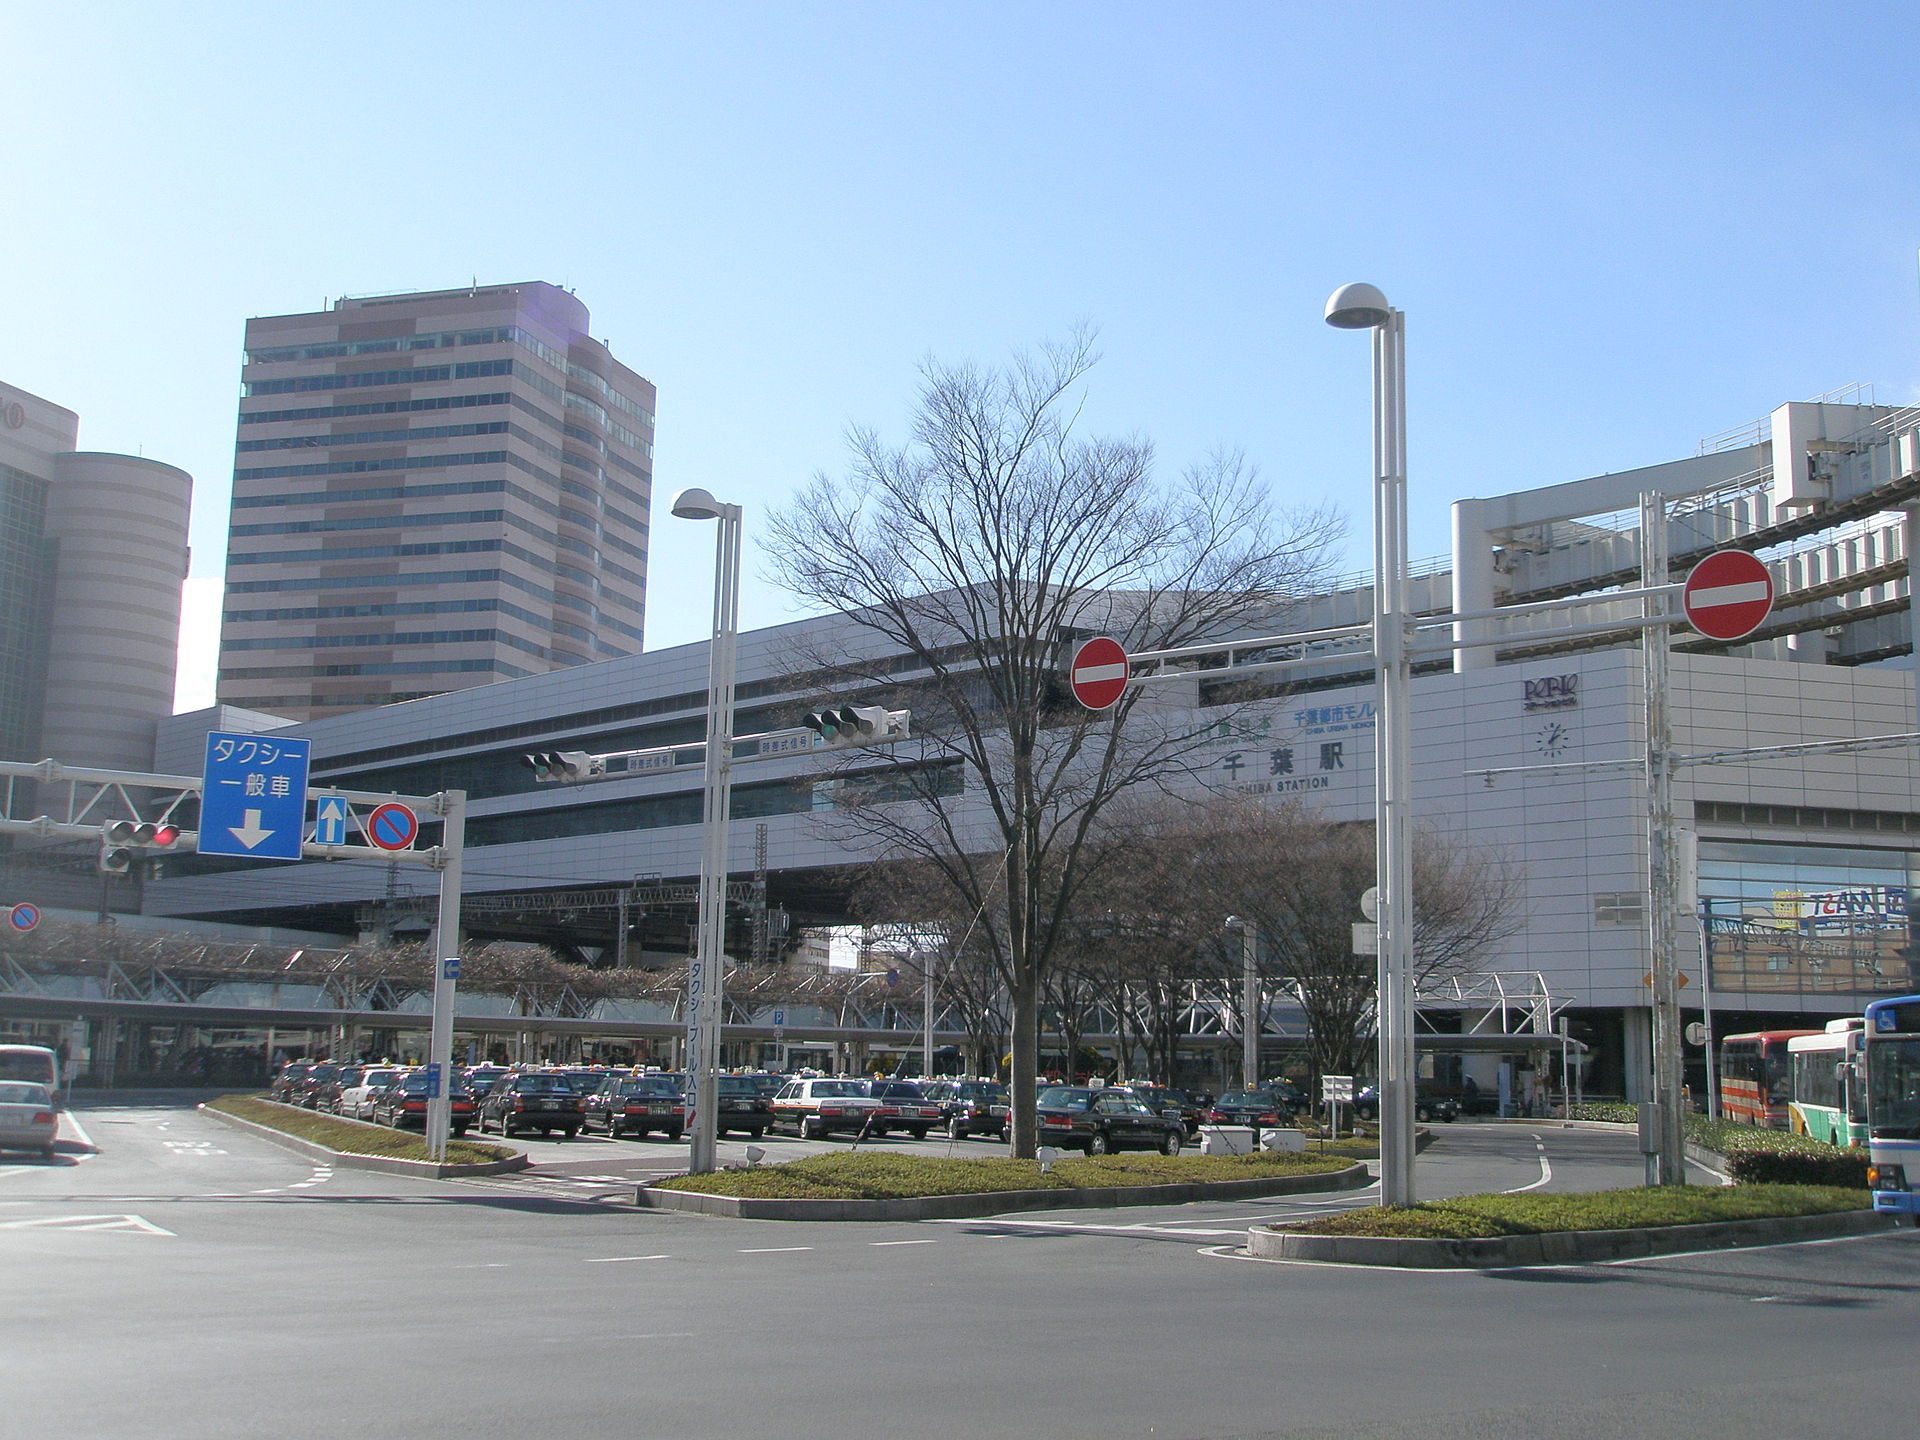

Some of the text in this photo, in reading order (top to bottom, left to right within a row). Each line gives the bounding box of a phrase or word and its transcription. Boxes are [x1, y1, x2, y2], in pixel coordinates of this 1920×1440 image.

[213, 739, 303, 765] タクシー
[1222, 742, 1345, 781] 千葉駅
[219, 772, 291, 799] 一般車
[1276, 776, 1329, 793] STATION
[686, 962, 700, 1107] タクシープール入口
